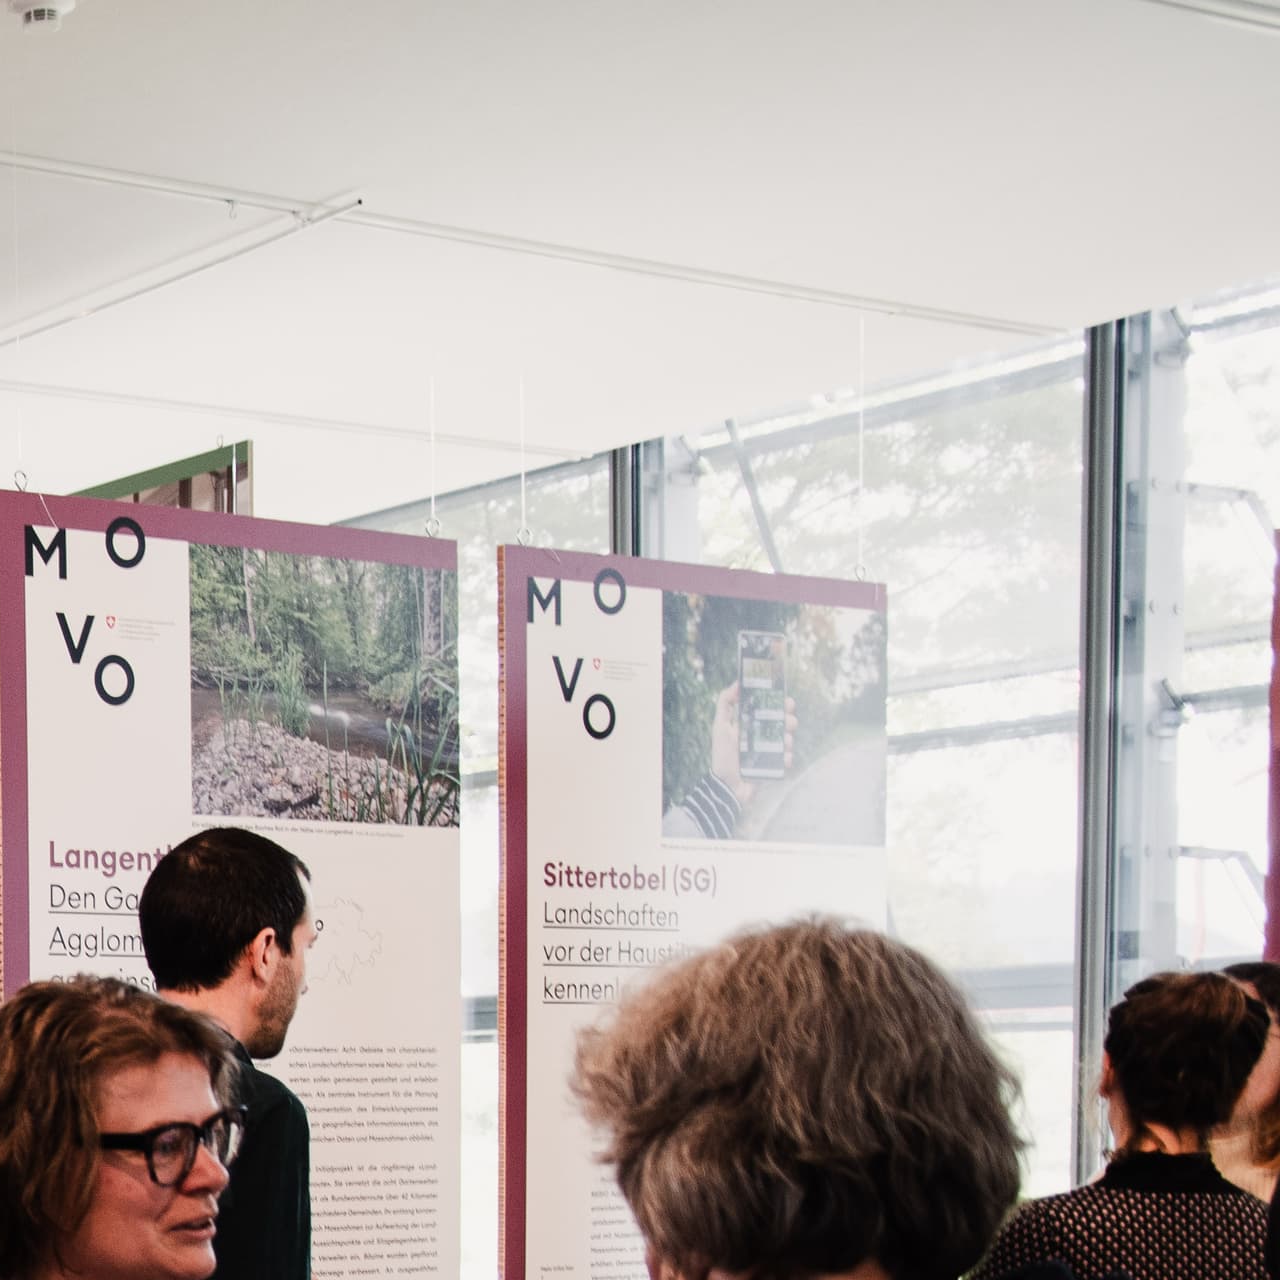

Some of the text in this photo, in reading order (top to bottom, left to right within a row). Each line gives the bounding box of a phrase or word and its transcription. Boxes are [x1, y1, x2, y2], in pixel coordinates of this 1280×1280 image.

[24, 516, 146, 580] M O
[527, 568, 626, 625] M O
[56, 612, 135, 705] V O
[552, 656, 616, 740] V O
[50, 841, 171, 877] Langent
[50, 884, 96, 909] Den
[544, 862, 717, 898] Sittertobel (SG)
[544, 902, 679, 927] Landschaften
[544, 945, 574, 961] vor
[580, 940, 612, 963] der
[544, 976, 626, 1000] kennenl
